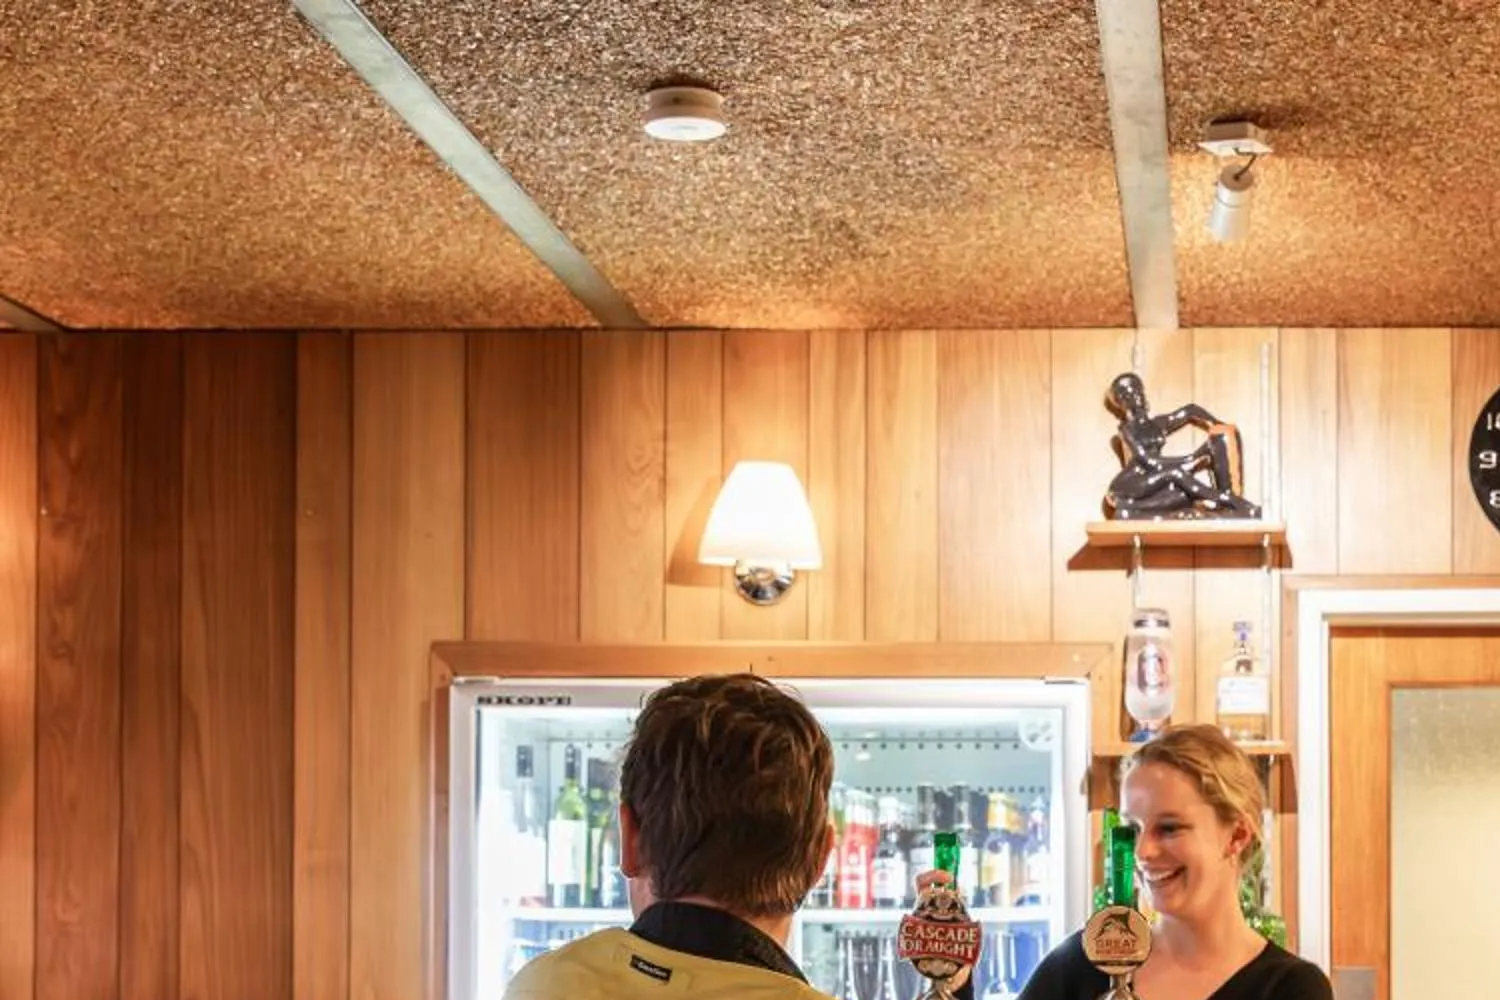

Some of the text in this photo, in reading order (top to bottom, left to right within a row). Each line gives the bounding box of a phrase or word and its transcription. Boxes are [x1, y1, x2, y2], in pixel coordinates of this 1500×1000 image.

[1478, 450, 1498, 470] 9
[901, 920, 978, 944] CASCADE
[901, 940, 975, 959] DRAUGHT
